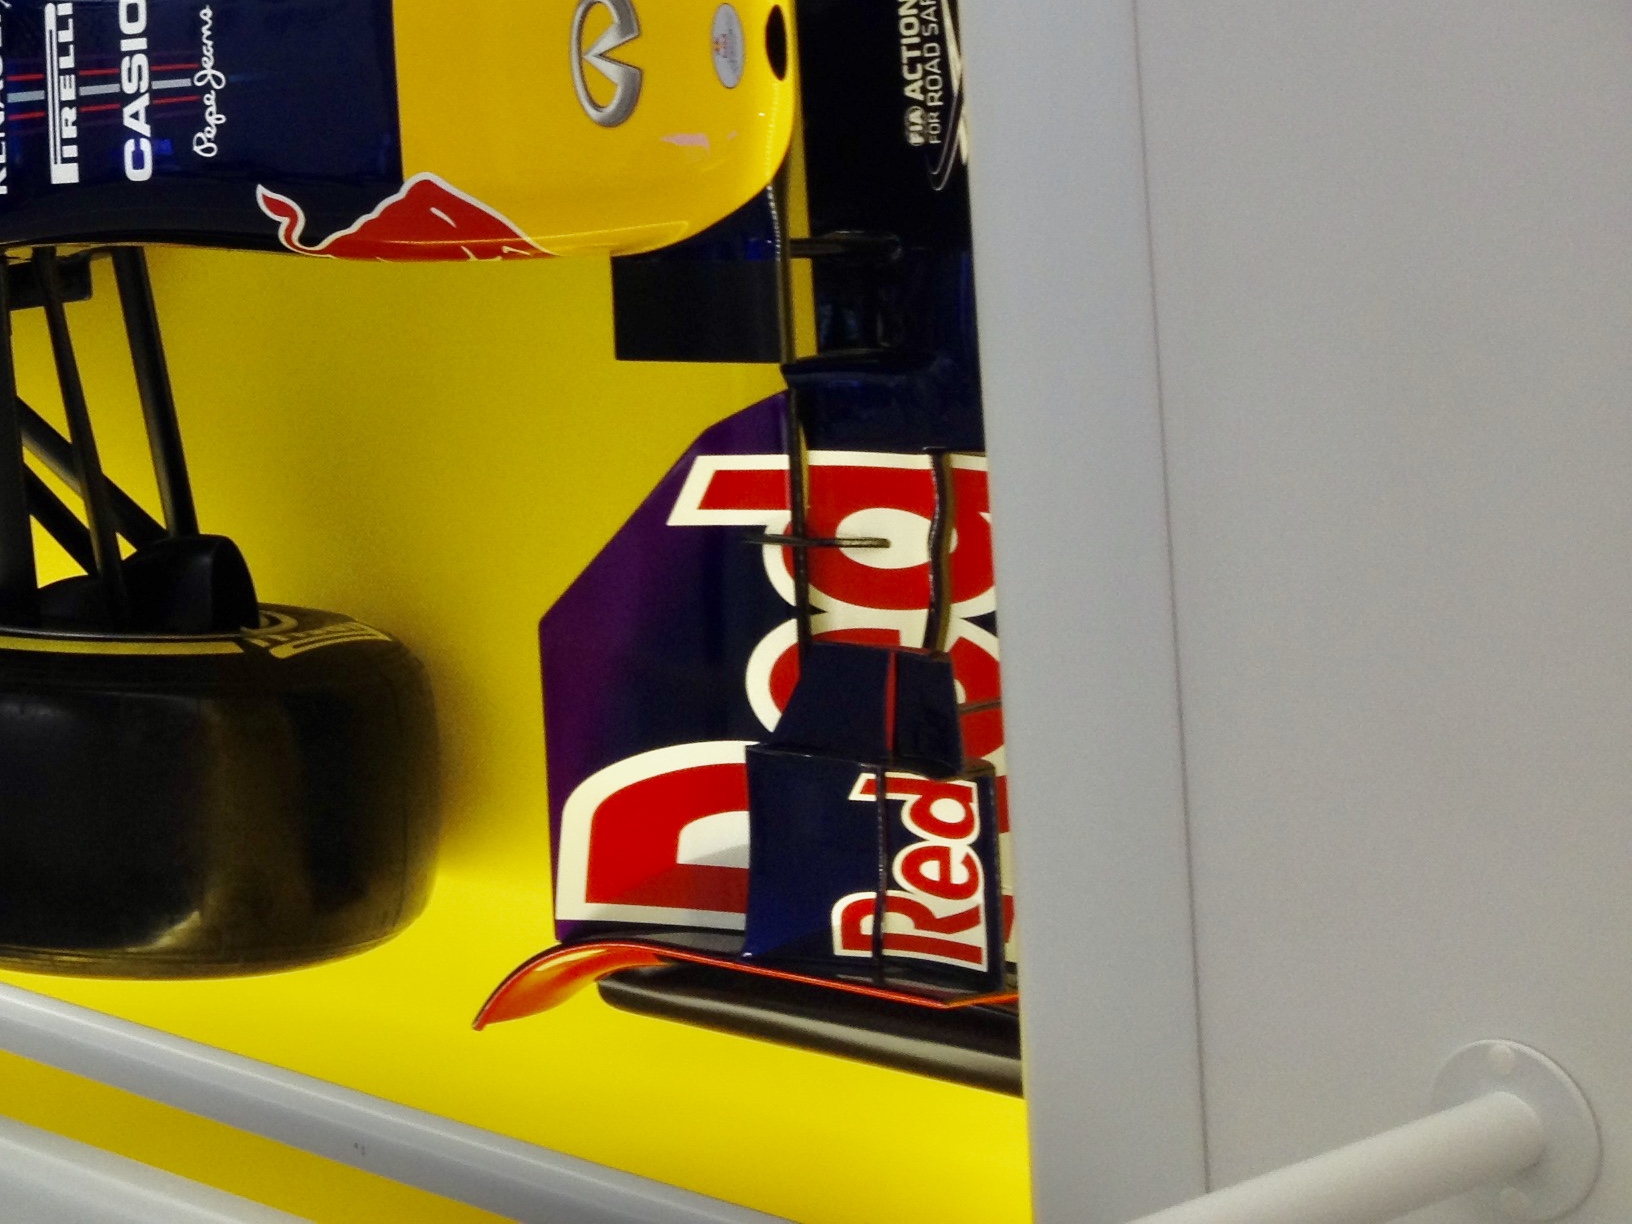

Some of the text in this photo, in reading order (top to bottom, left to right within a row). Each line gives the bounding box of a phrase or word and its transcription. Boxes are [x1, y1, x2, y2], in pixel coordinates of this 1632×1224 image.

[44, 2, 79, 185] PIRELLI
[193, 5, 225, 158] Pepe Jeans
[904, 106, 925, 147] FIA
[923, 42, 945, 107] ROAD
[928, 111, 943, 145] FOR
[831, 771, 988, 973] Red
